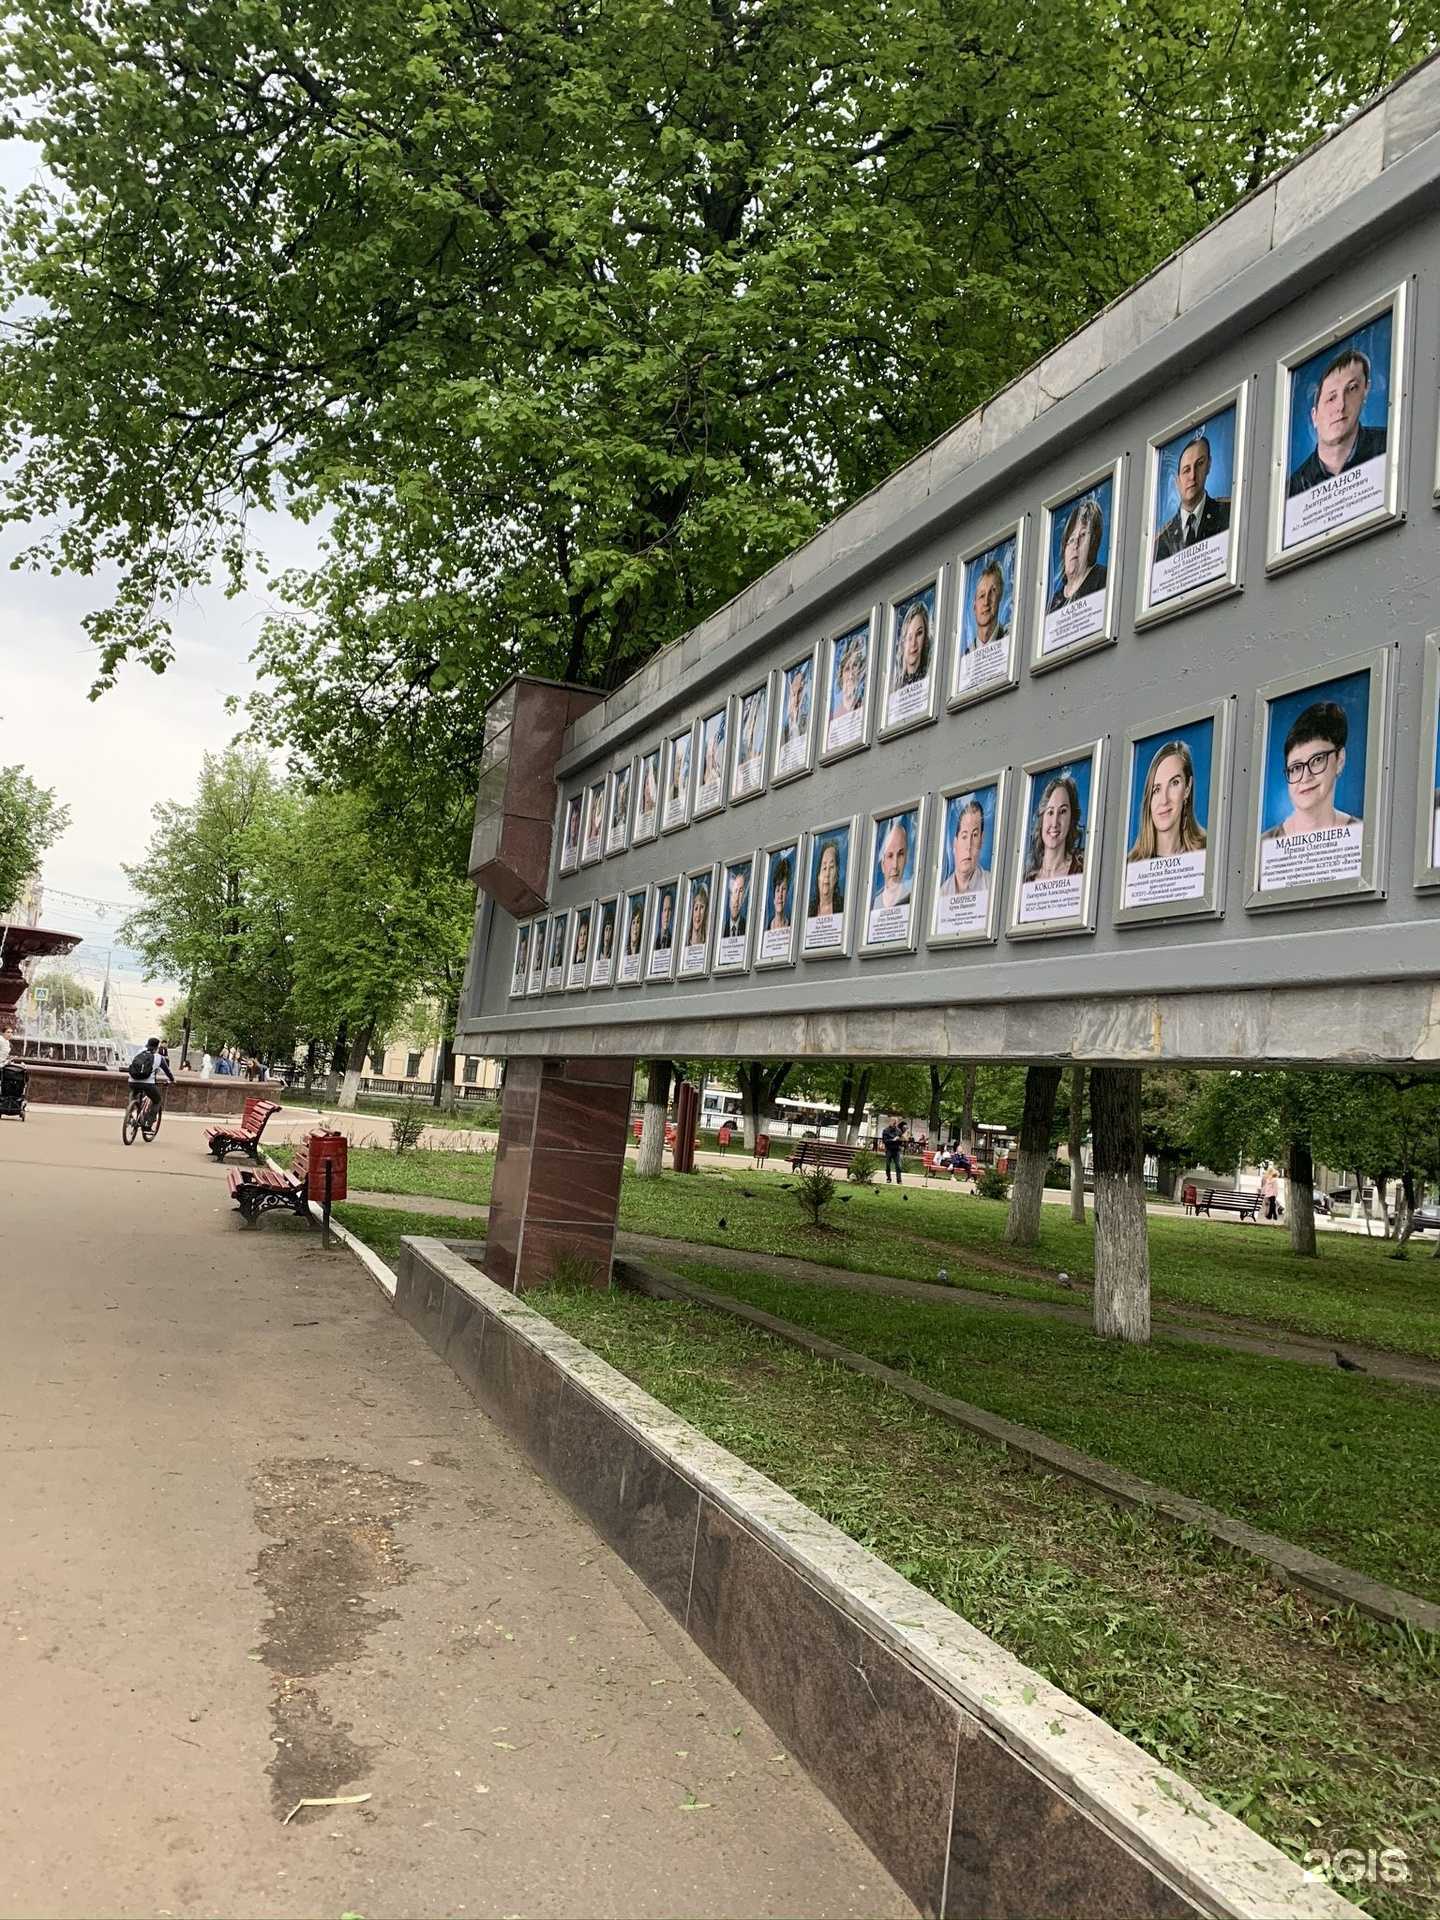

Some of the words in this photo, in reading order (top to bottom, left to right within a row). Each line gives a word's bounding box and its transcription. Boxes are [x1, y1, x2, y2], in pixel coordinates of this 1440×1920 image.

[1311, 469, 1362, 500] ТУМАНОВ
[1276, 828, 1351, 849] МАШКОВЦЕВА
[1150, 858, 1182, 870] ГЛУХИХ
